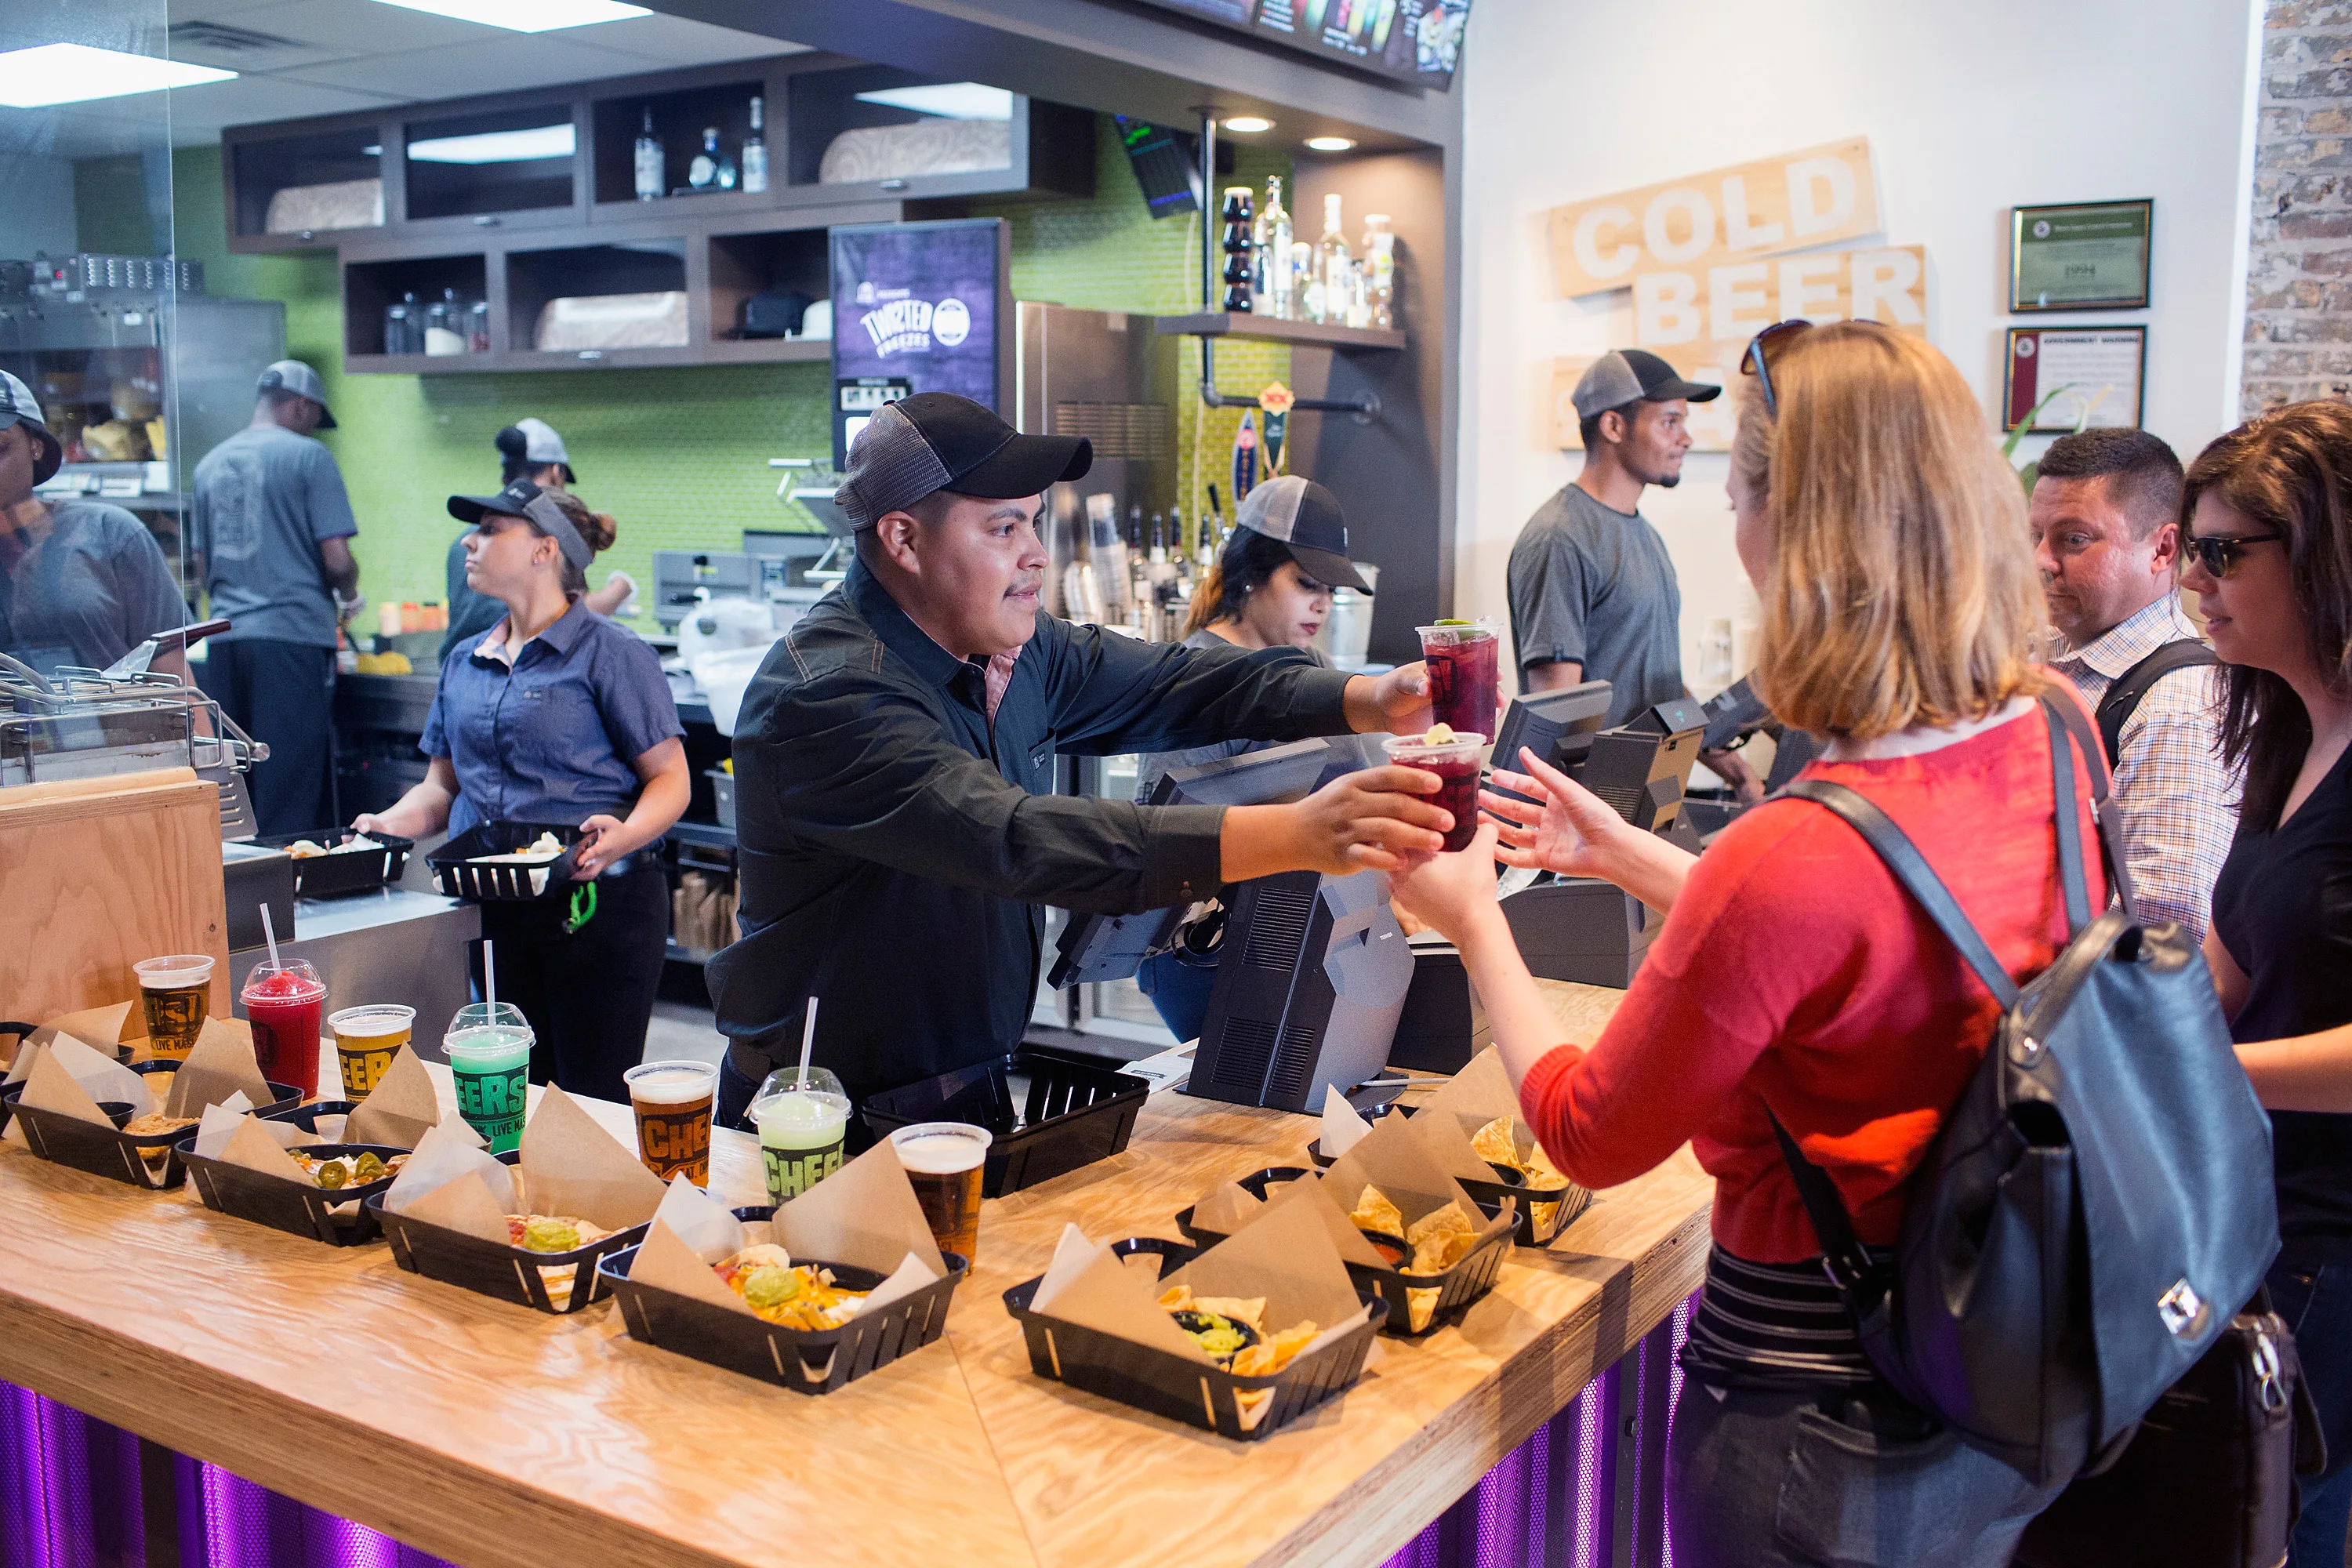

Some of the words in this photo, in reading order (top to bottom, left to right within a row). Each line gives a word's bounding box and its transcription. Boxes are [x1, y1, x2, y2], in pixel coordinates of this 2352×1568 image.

[1573, 155, 1857, 279] COLD
[1636, 249, 1926, 345] BEER
[492, 1121, 513, 1137] LIVE
